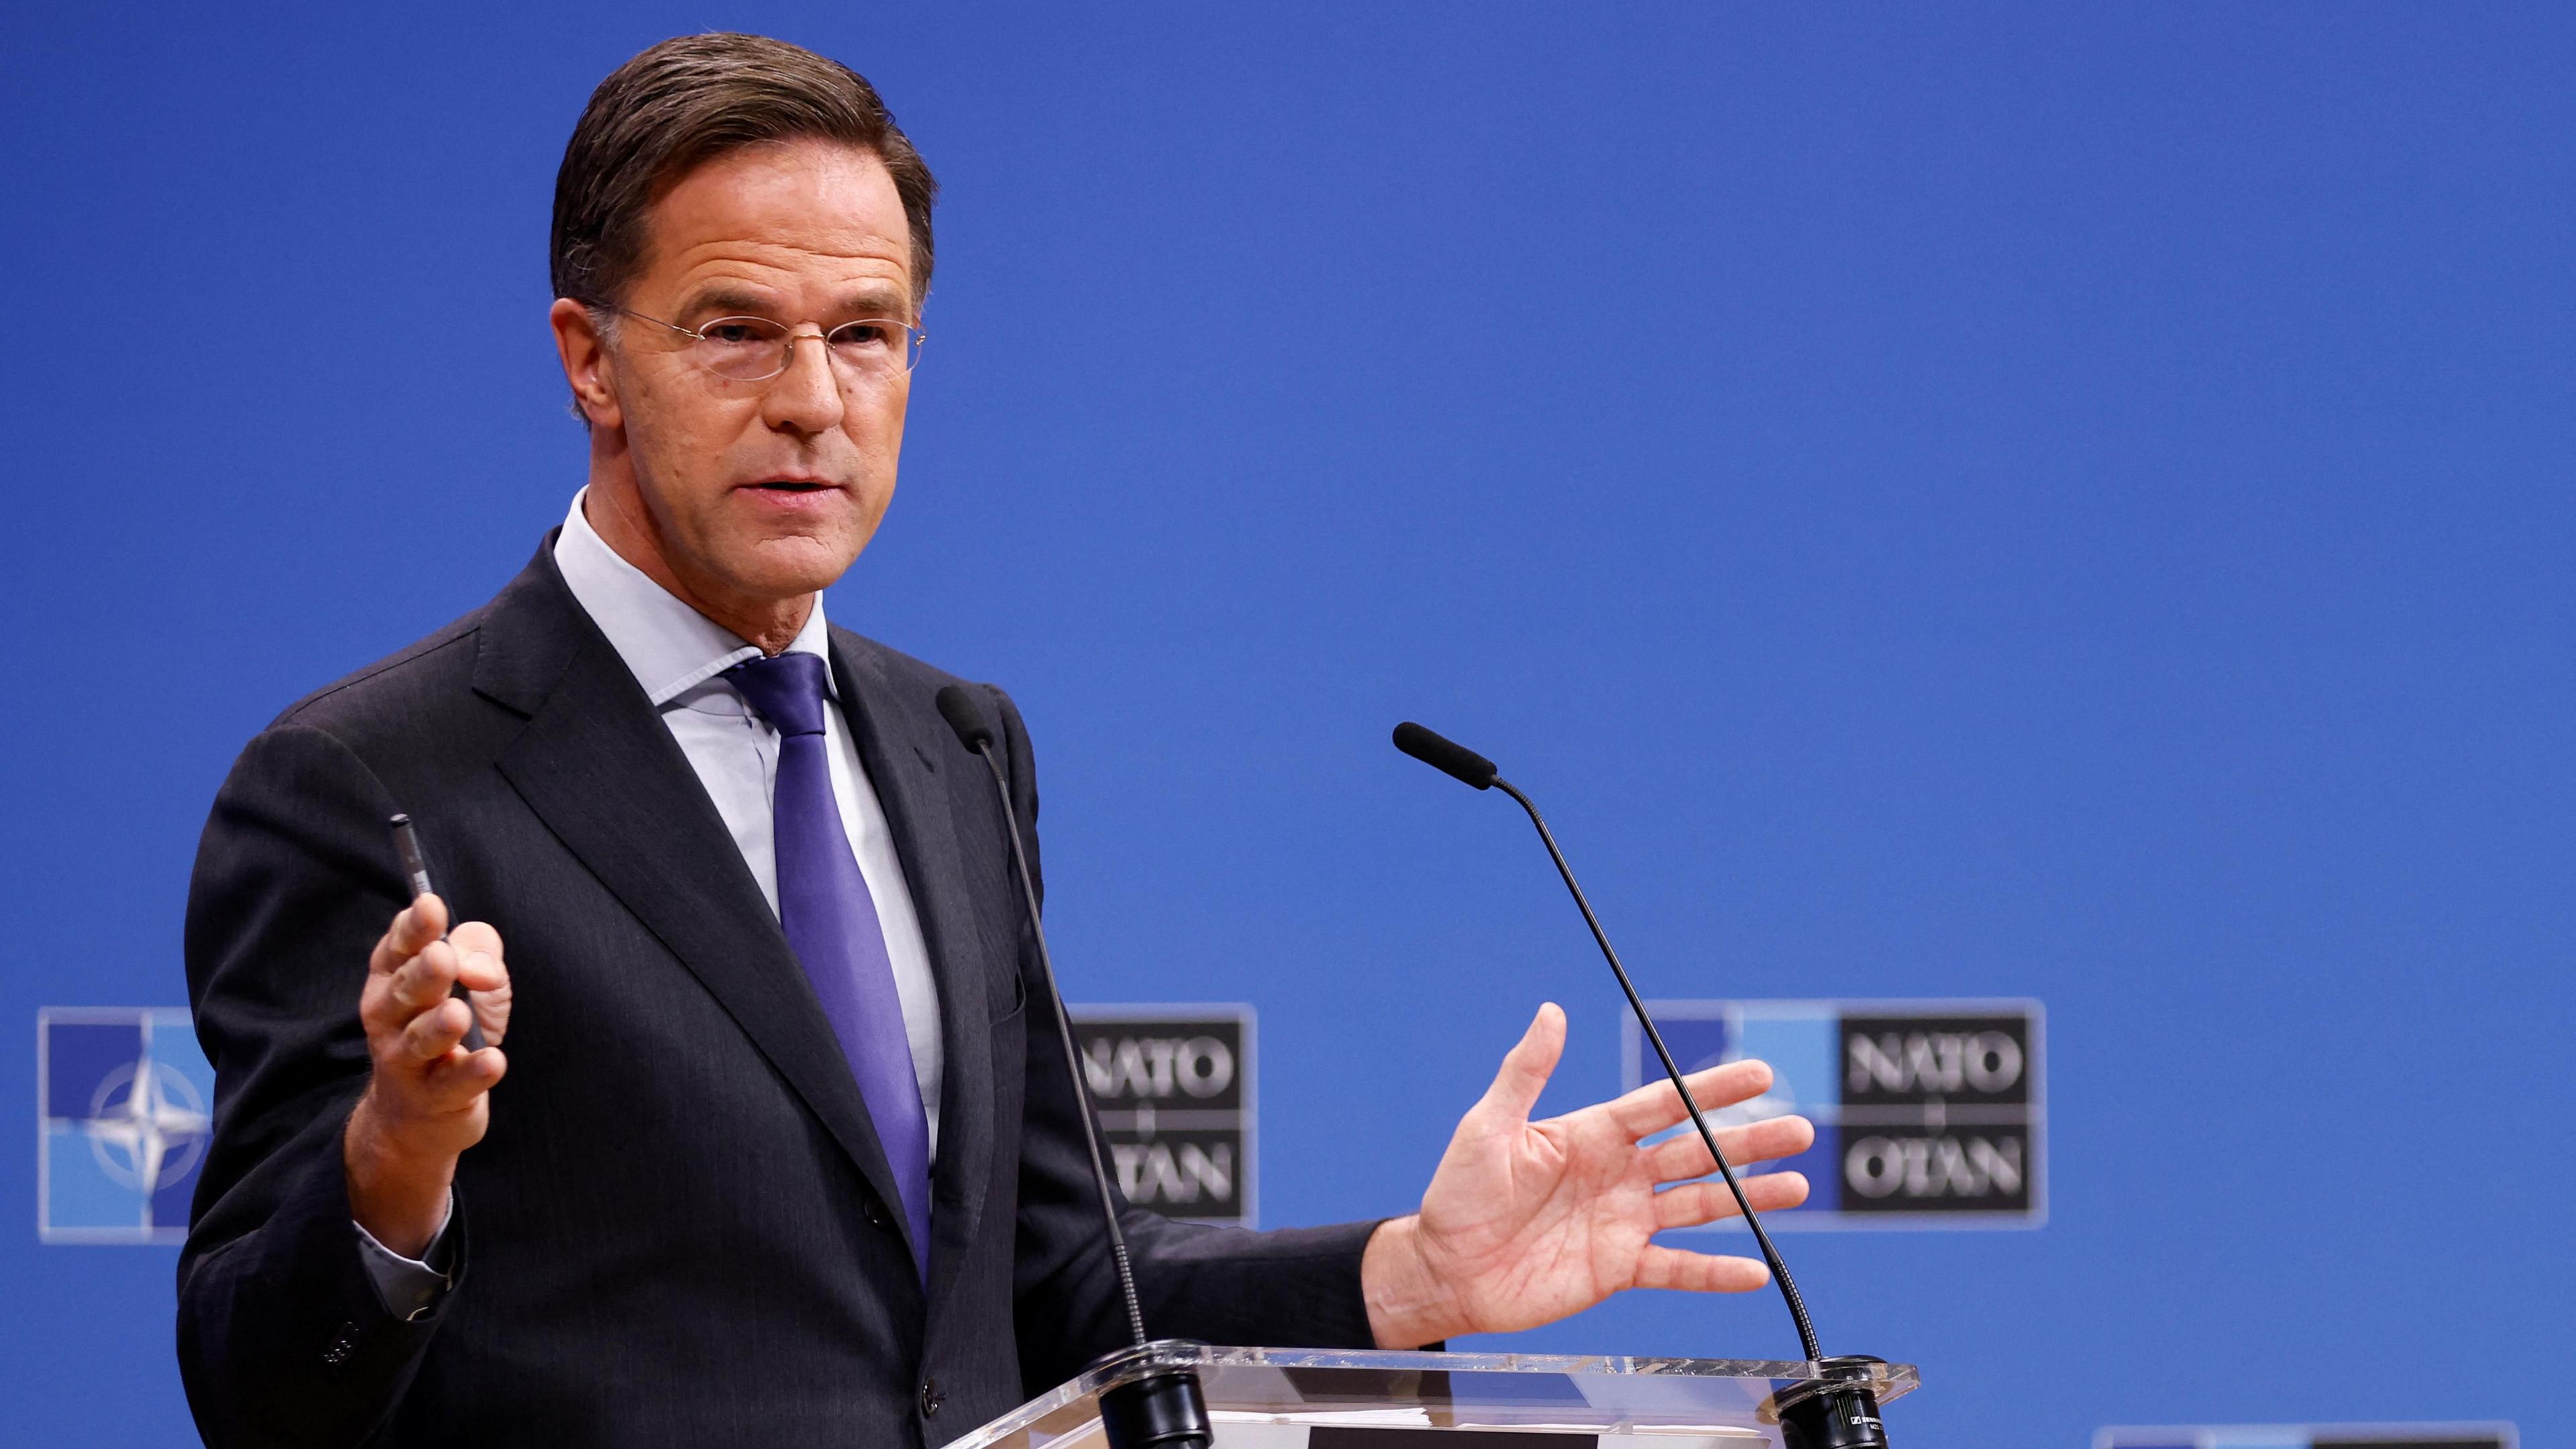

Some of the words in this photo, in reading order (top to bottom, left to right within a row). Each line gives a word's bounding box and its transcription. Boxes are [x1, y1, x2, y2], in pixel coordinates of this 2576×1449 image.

[1081, 1036, 1234, 1098] NATO
[1848, 1030, 2023, 1093] NATO
[1111, 1142, 1232, 1203] TAN
[1845, 1136, 2022, 1198] OTAN
